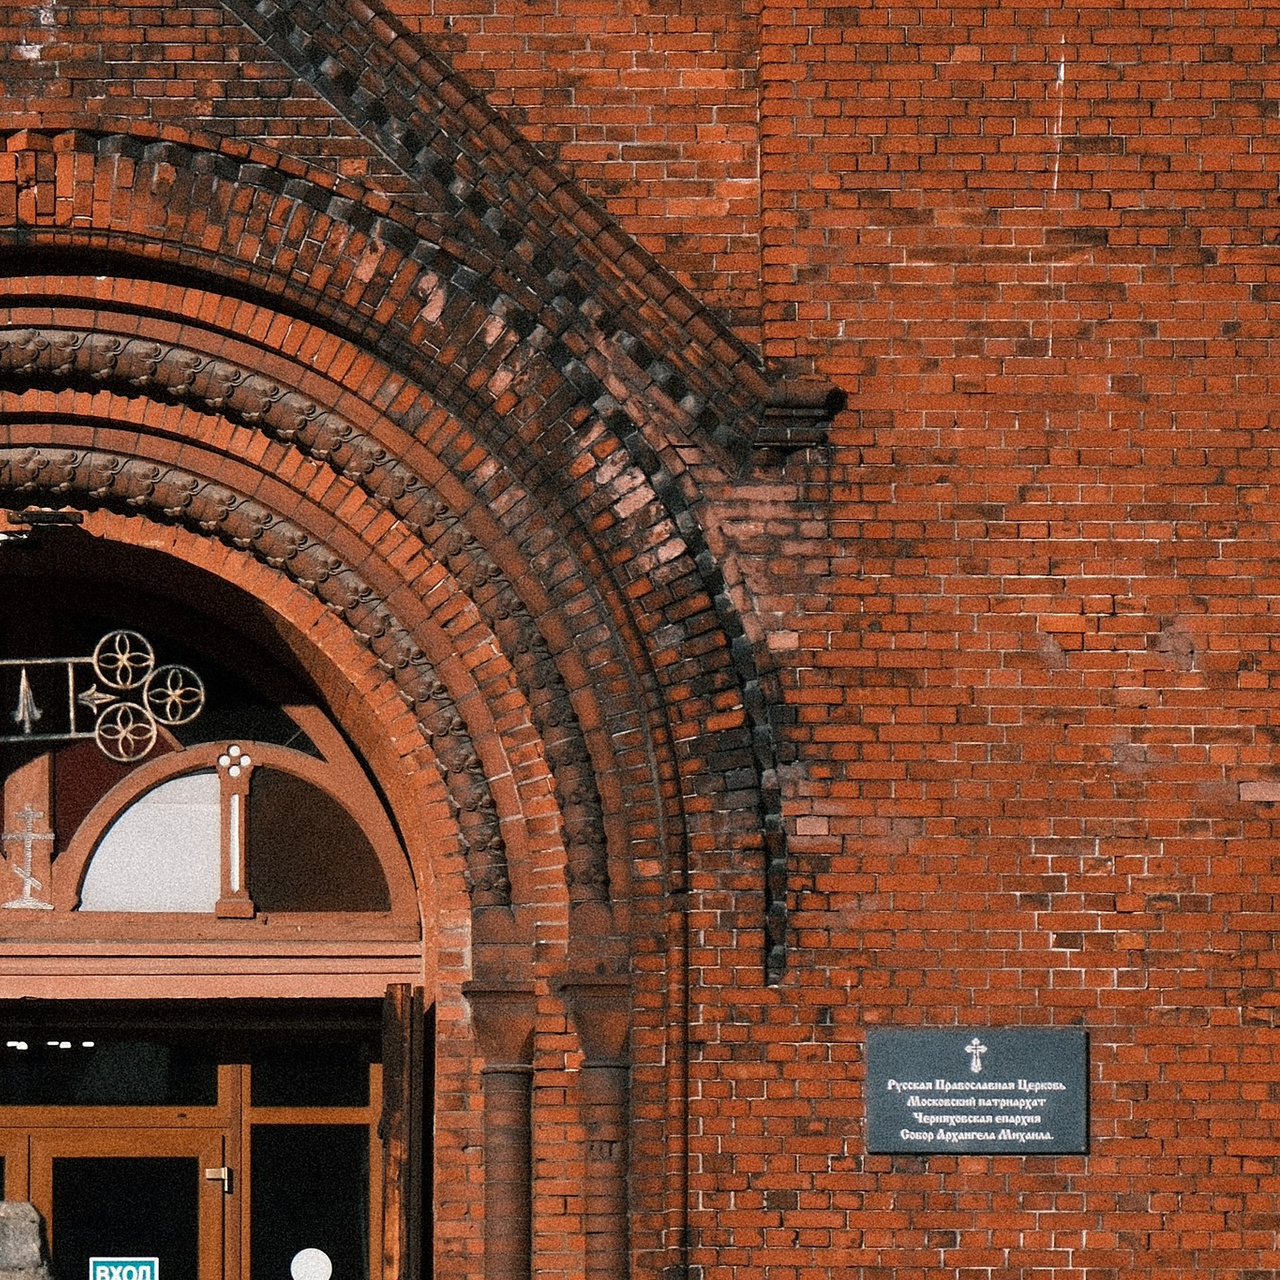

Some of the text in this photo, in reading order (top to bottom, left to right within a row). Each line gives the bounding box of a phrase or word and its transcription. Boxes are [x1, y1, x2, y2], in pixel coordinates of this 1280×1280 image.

[887, 1079, 1067, 1093] Русская Православная Церковь
[907, 1096, 1047, 1110] Московский патриархат
[912, 1112, 1042, 1126] Черняховская епархия
[900, 1128, 1055, 1143] Собор Архангела Михаила.
